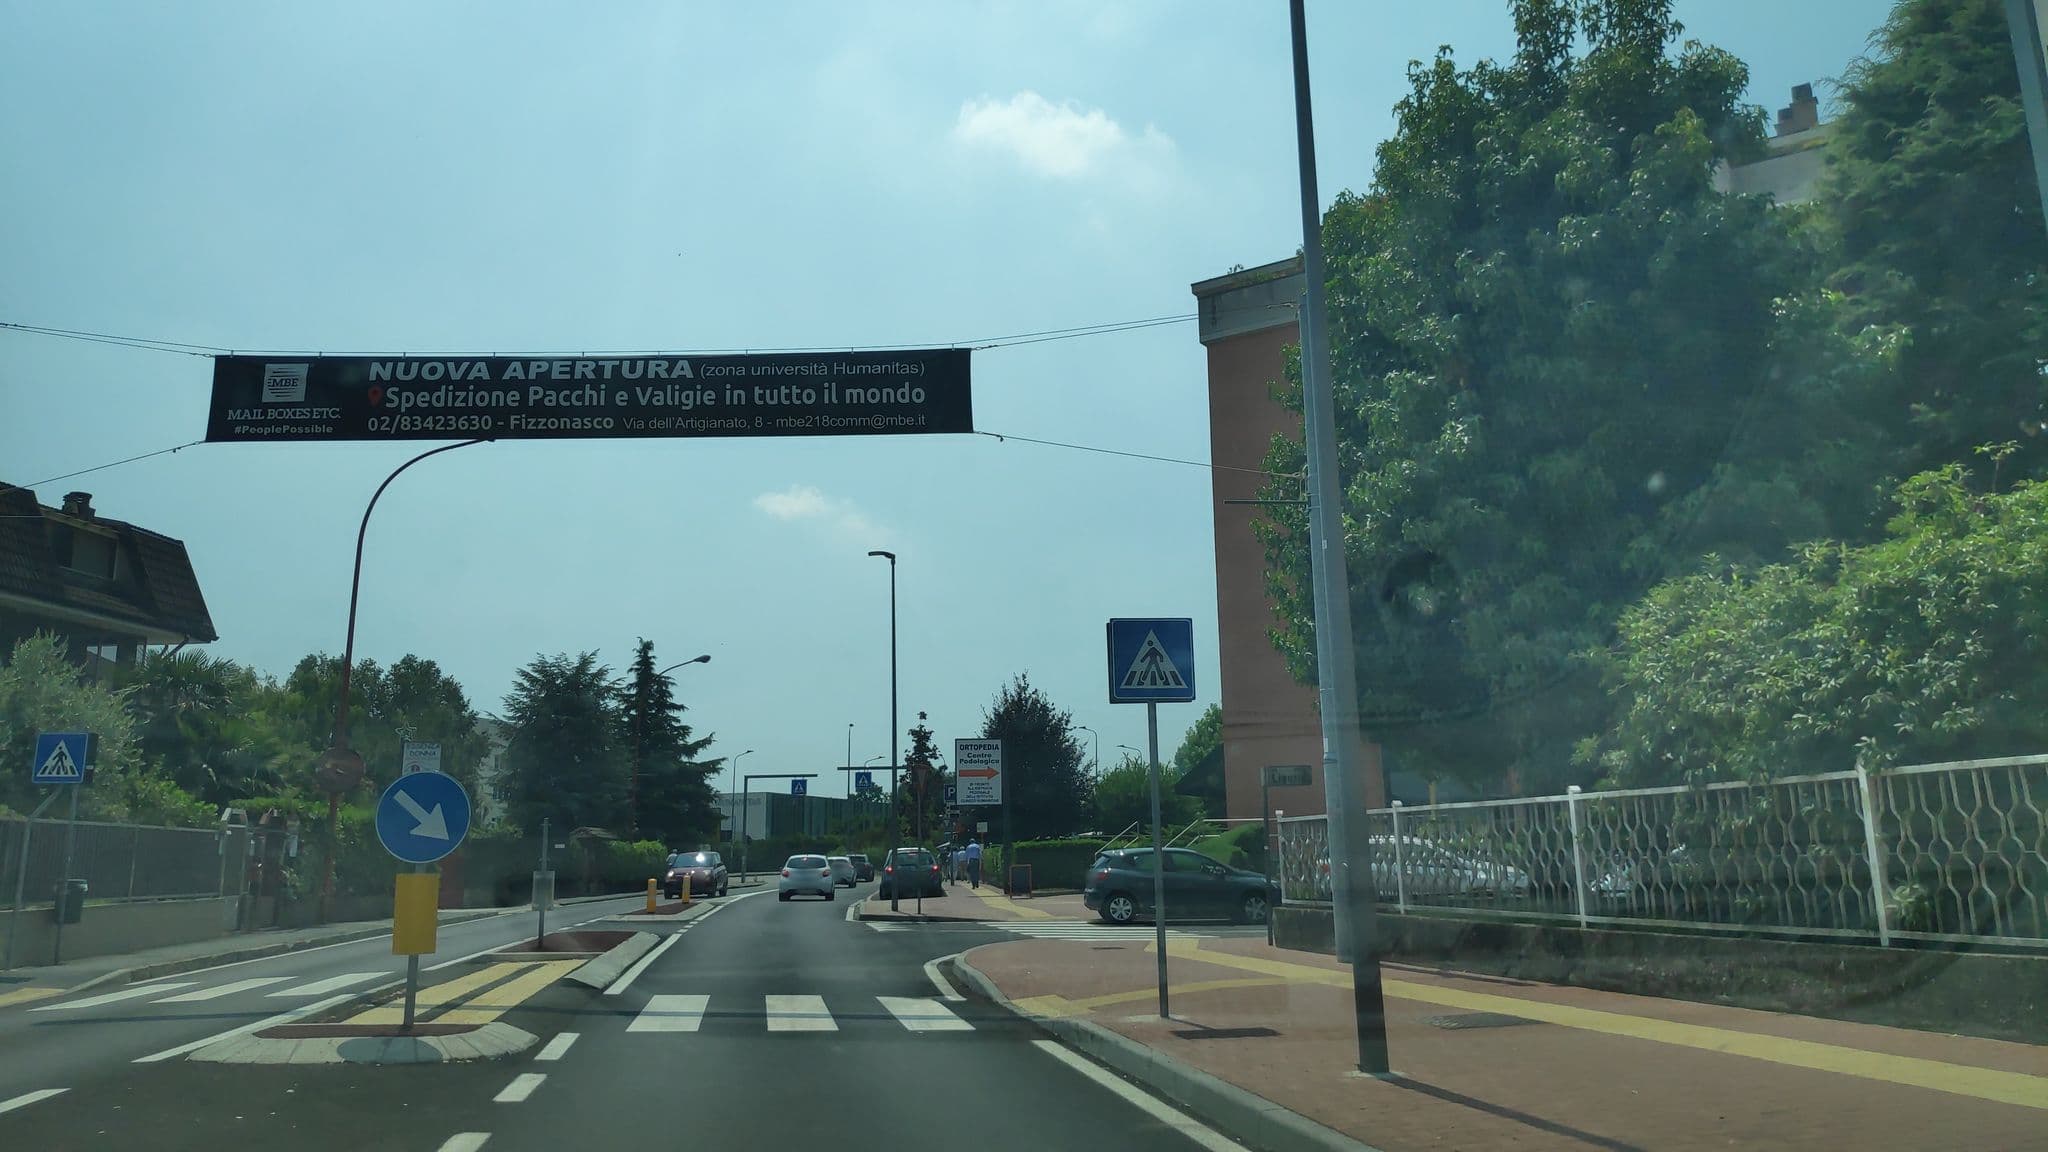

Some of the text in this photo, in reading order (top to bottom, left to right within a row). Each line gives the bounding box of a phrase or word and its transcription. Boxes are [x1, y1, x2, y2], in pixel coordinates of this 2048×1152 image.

[368, 359, 694, 381] NUOVA APERTURA
[700, 360, 925, 380] (zona università Humanitas)
[385, 382, 925, 412] Spedizione Pacchi e Valigie in tutto il mondo
[227, 407, 341, 420] MAIL BOXES ETC.
[623, 417, 645, 430] Via
[755, 415, 763, 428] 8
[776, 414, 925, 429] mbe218comm@mbe.it
[234, 424, 333, 436] #PeoplePossible
[367, 415, 492, 434] 02/83423630
[510, 414, 615, 431] Fizzonasco
[959, 743, 999, 751] ORTOPEDIA
